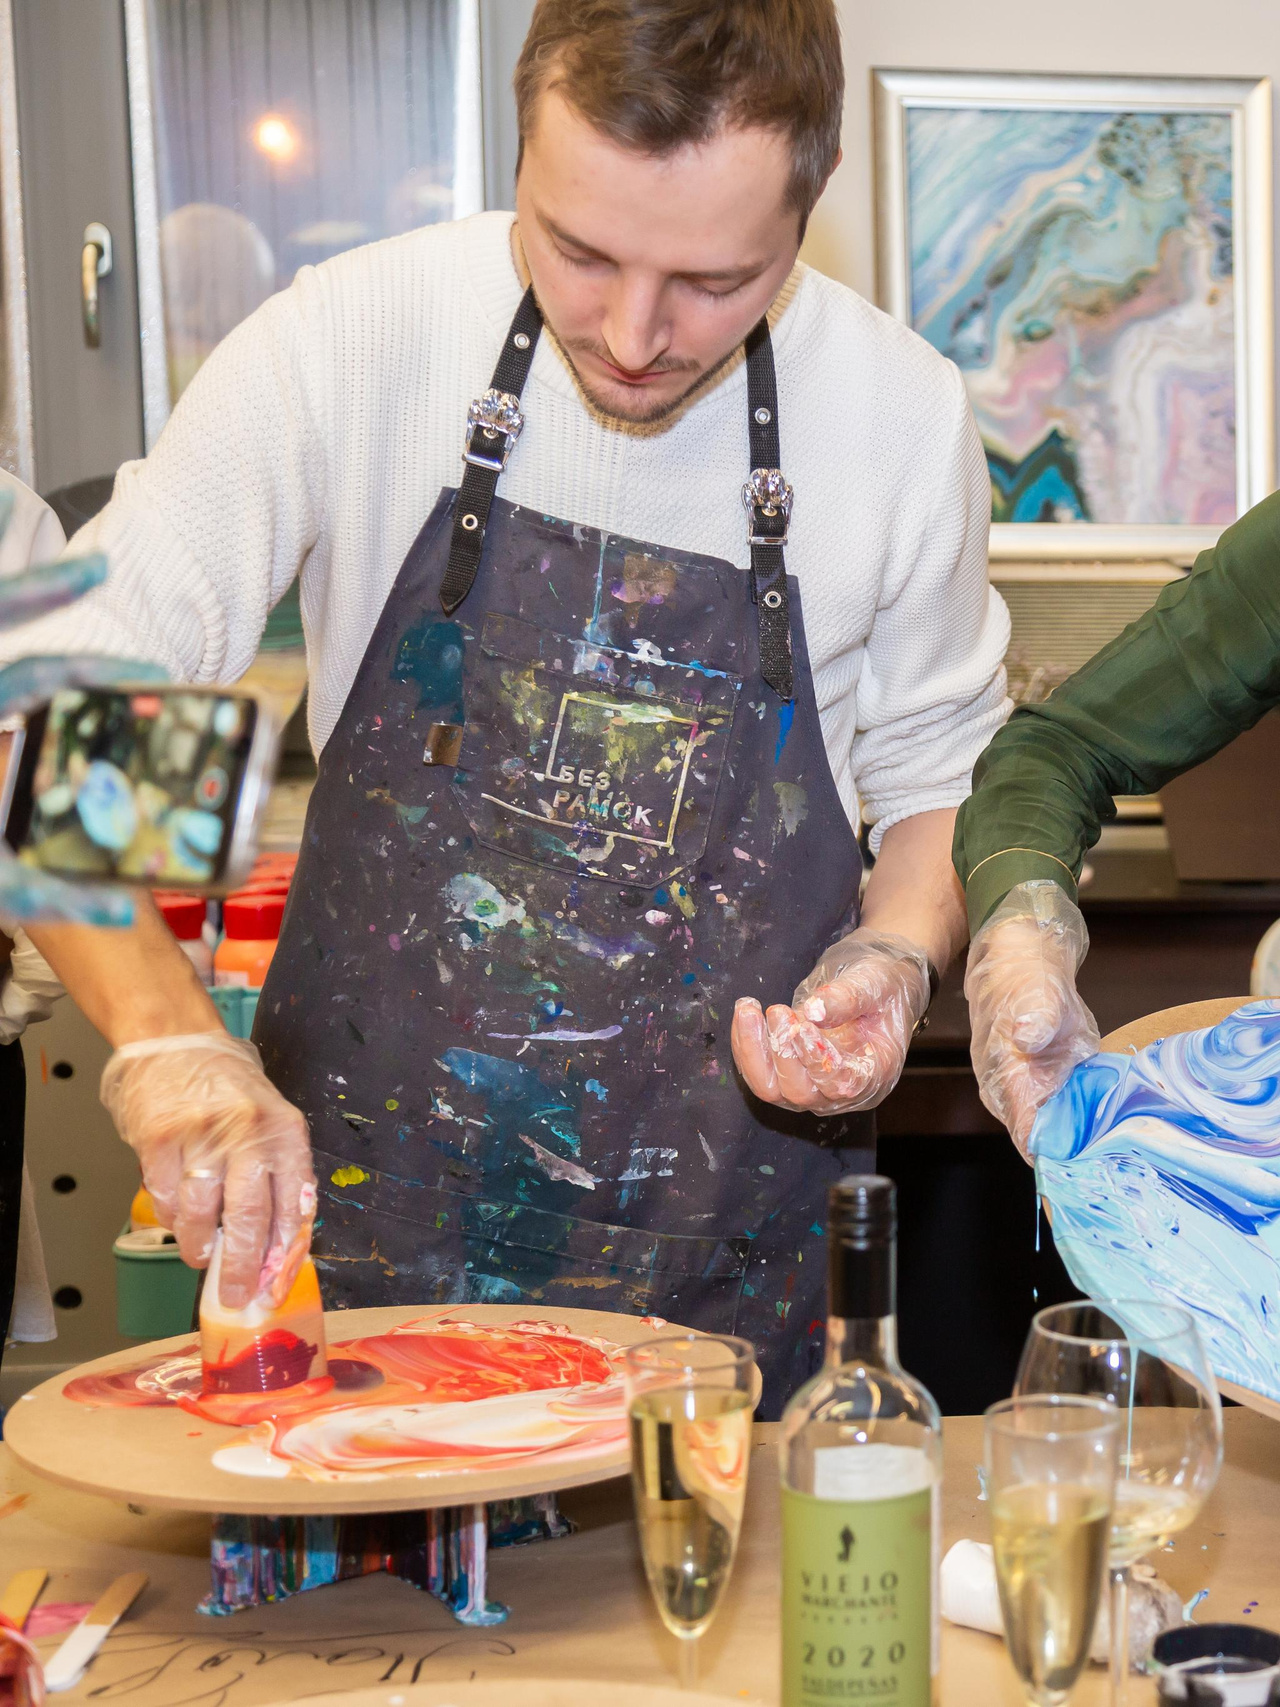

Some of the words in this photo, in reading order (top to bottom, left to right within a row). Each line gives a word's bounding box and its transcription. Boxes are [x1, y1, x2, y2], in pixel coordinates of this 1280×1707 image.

[559, 765, 611, 790] БЕЗ
[552, 789, 654, 827] РАМОК
[801, 1571, 899, 1594] VIEJO
[803, 1640, 907, 1669] 2020
